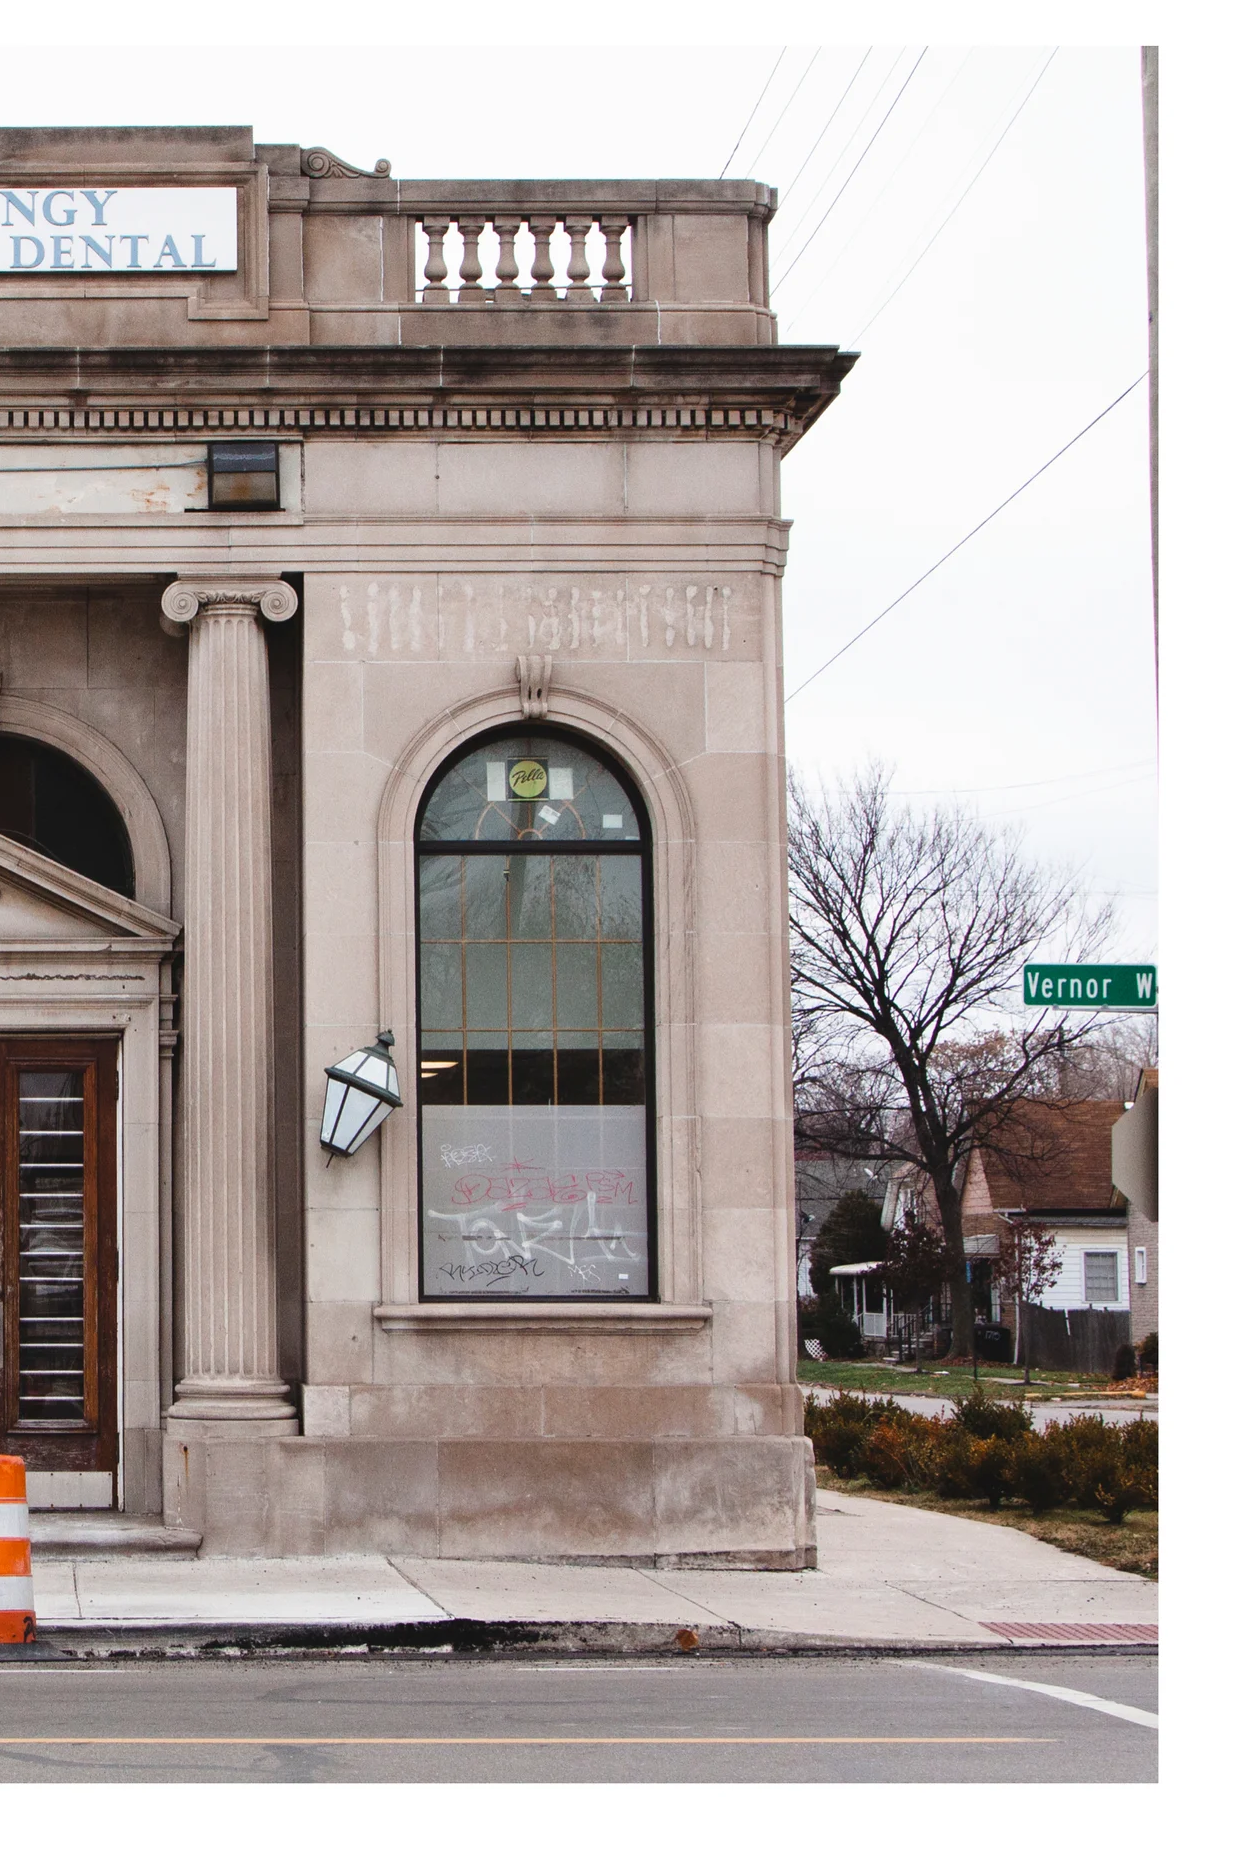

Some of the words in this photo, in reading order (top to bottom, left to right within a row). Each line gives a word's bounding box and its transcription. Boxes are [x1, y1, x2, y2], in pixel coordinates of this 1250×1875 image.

[9, 234, 217, 268] DENTAL
[512, 769, 544, 787] Pella
[1027, 972, 1112, 998] Vernor
[1136, 973, 1153, 999] W
